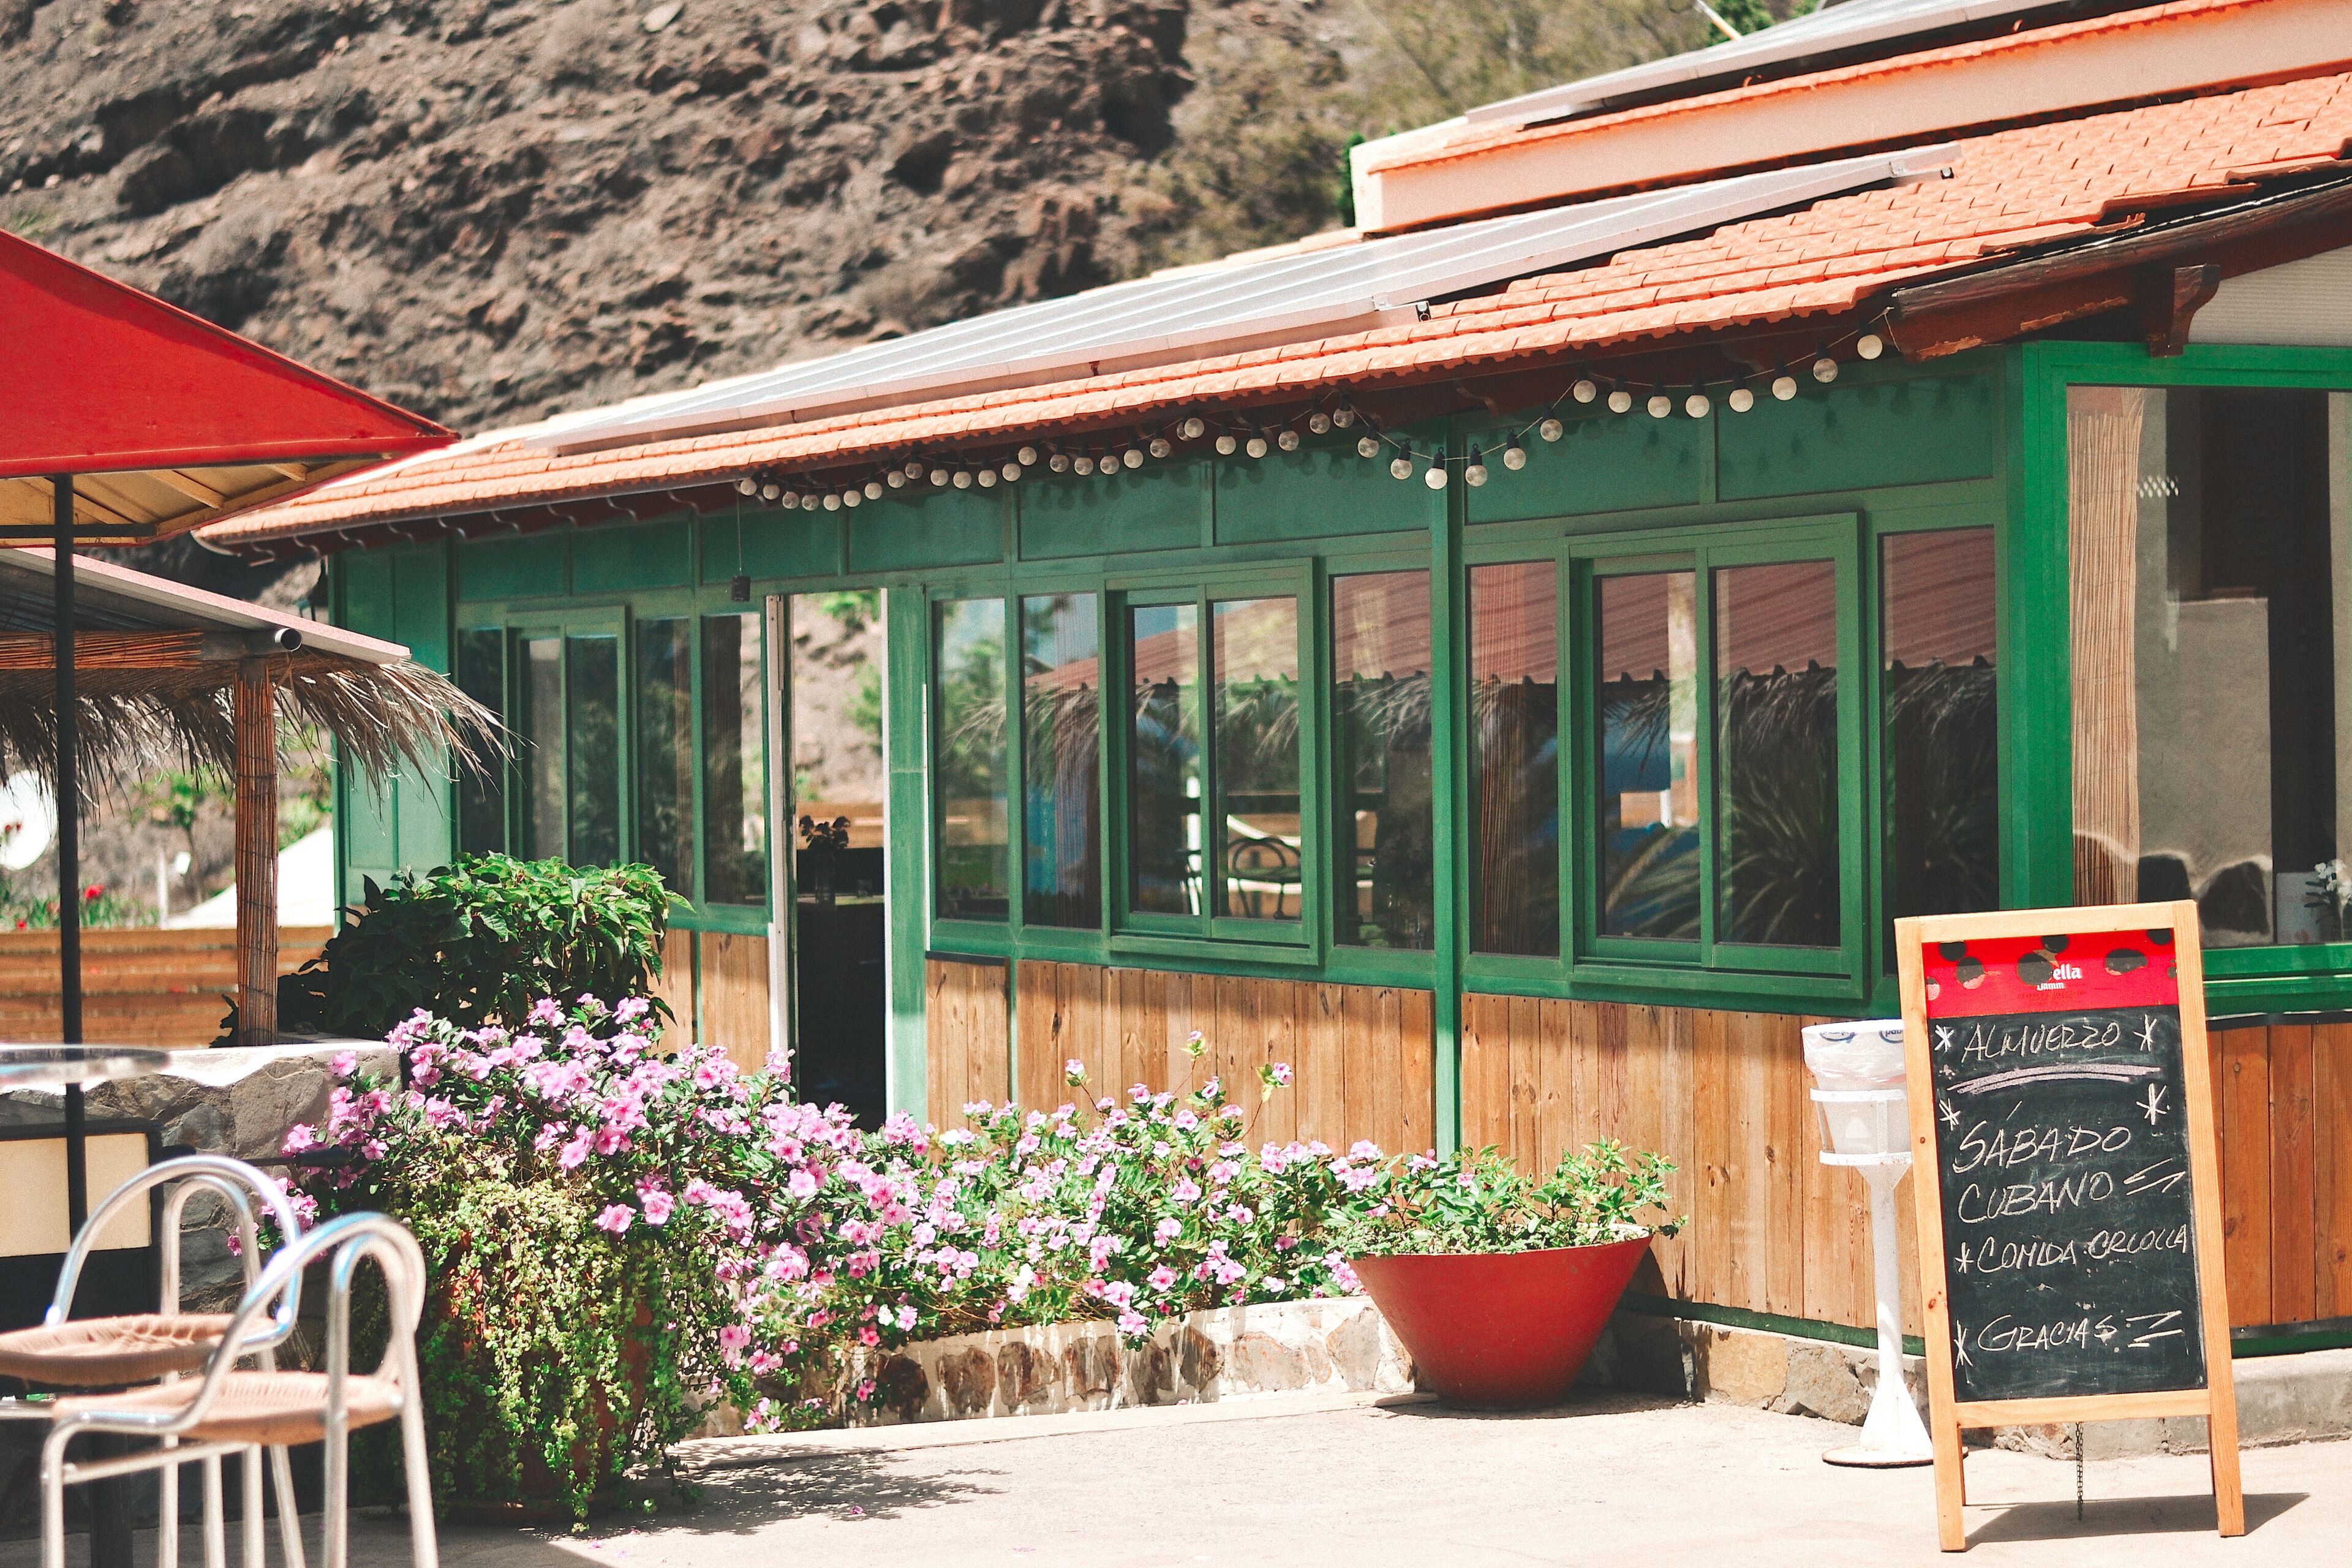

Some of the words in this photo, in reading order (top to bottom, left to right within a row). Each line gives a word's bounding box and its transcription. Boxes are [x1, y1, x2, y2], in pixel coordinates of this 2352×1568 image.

[1961, 1022, 2120, 1063] ALMUERZO
[1952, 1100, 2132, 1174] SÁBADO
[1958, 1170, 2114, 1224] CUBANO
[1977, 1236, 2077, 1273] COMIDA
[1977, 1314, 2117, 1352] GRACIAS
